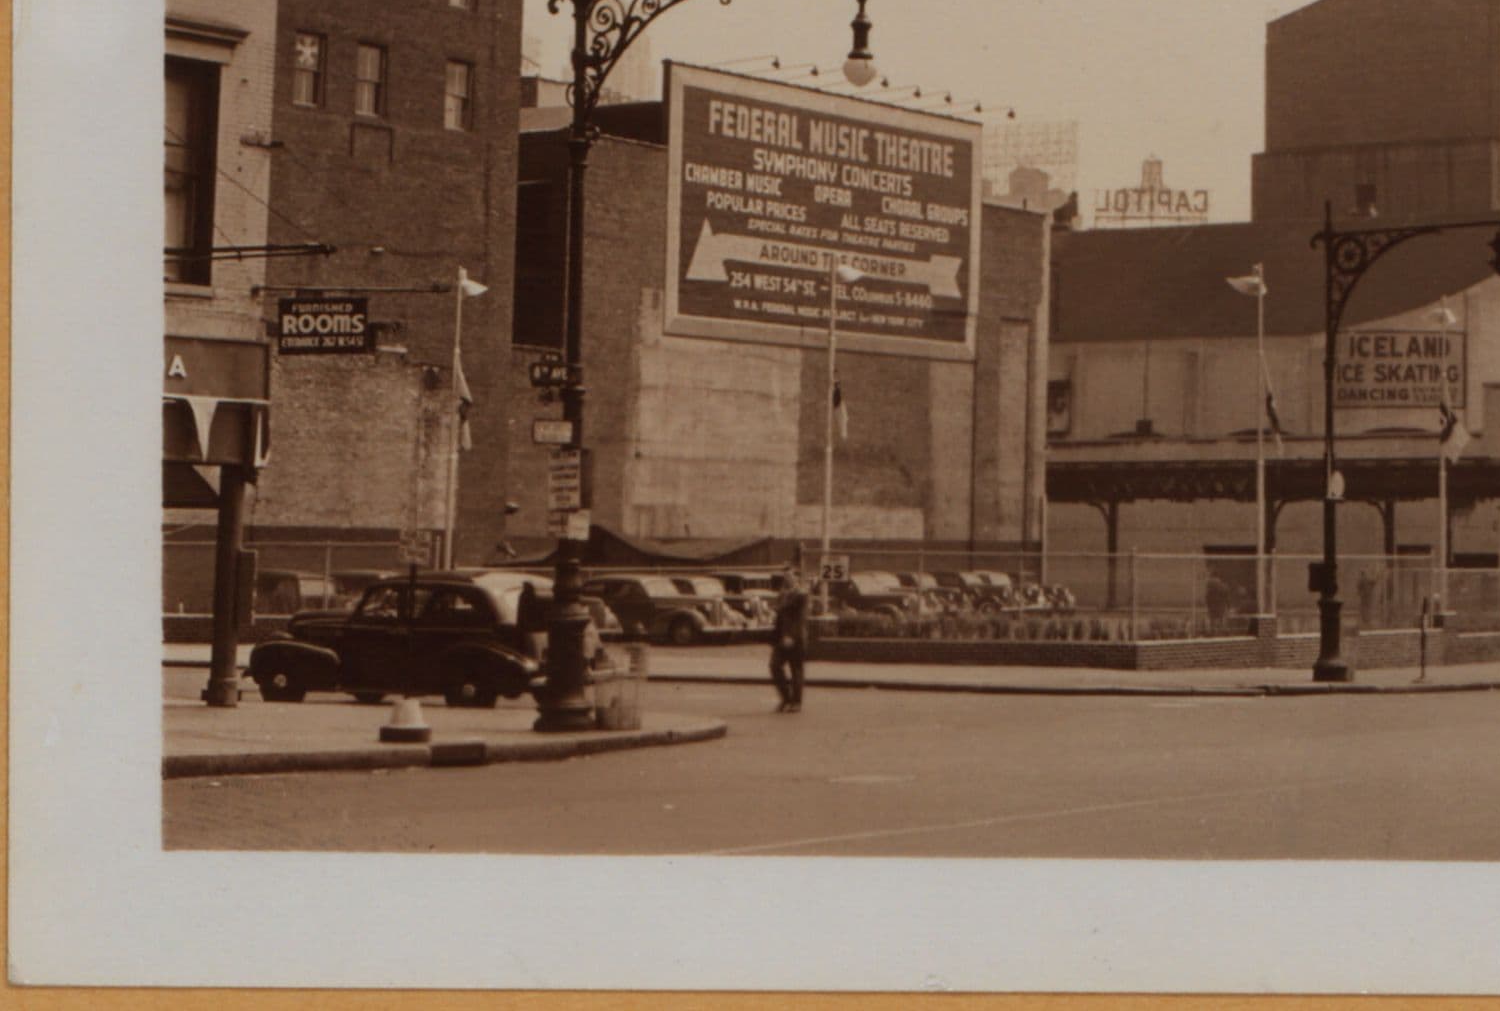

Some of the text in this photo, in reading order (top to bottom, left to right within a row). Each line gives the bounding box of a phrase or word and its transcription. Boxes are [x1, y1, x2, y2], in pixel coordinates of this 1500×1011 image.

[709, 99, 954, 178] FEDERAL MUSIC THEATRE
[753, 148, 912, 197] SYMPHONY CONCERTS
[685, 162, 743, 190] CHAMBER
[745, 172, 783, 196] MUSIC
[814, 184, 852, 207] OPERA
[926, 203, 968, 227] GROUPS
[706, 190, 950, 243] POPULAR PRICES ALL SEATS RESERVED
[760, 244, 907, 278] AROUND TE CORNER
[729, 271, 751, 288] 254
[753, 274, 781, 291] WEST
[290, 303, 353, 313] FURNISHED
[282, 313, 365, 334] ROOMS
[1349, 336, 1451, 357] ICELAND
[1336, 364, 1364, 382] ICE
[1337, 388, 1409, 400] DANCING
[822, 564, 843, 579] 25
